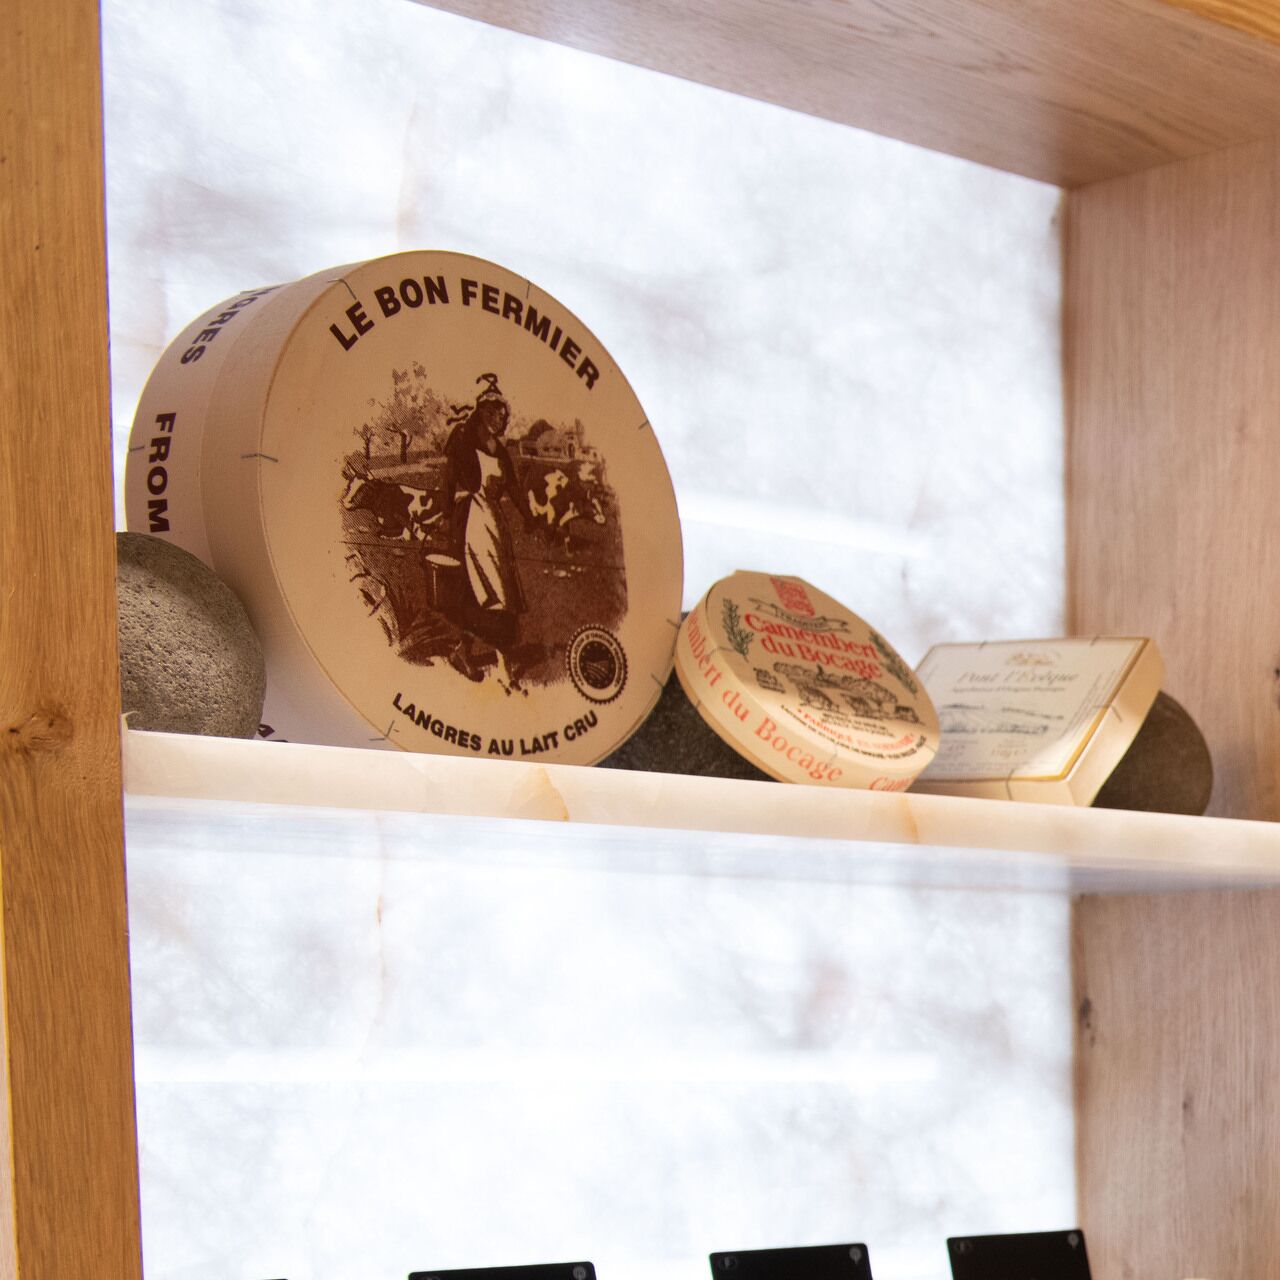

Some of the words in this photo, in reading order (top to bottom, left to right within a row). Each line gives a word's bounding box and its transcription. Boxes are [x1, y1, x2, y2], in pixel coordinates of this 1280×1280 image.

[329, 301, 375, 351] LE
[374, 275, 449, 319] BON
[461, 278, 600, 390] FERMIER
[146, 411, 177, 533] FROM
[744, 612, 881, 661] Camembert
[760, 632, 796, 659] du
[796, 644, 883, 680] Bocage
[392, 692, 482, 752] LANGRES
[487, 737, 515, 756] AU
[520, 731, 560, 756] LAIT
[563, 709, 599, 742] CRU
[721, 686, 750, 723] du
[754, 716, 844, 782] Bocage
